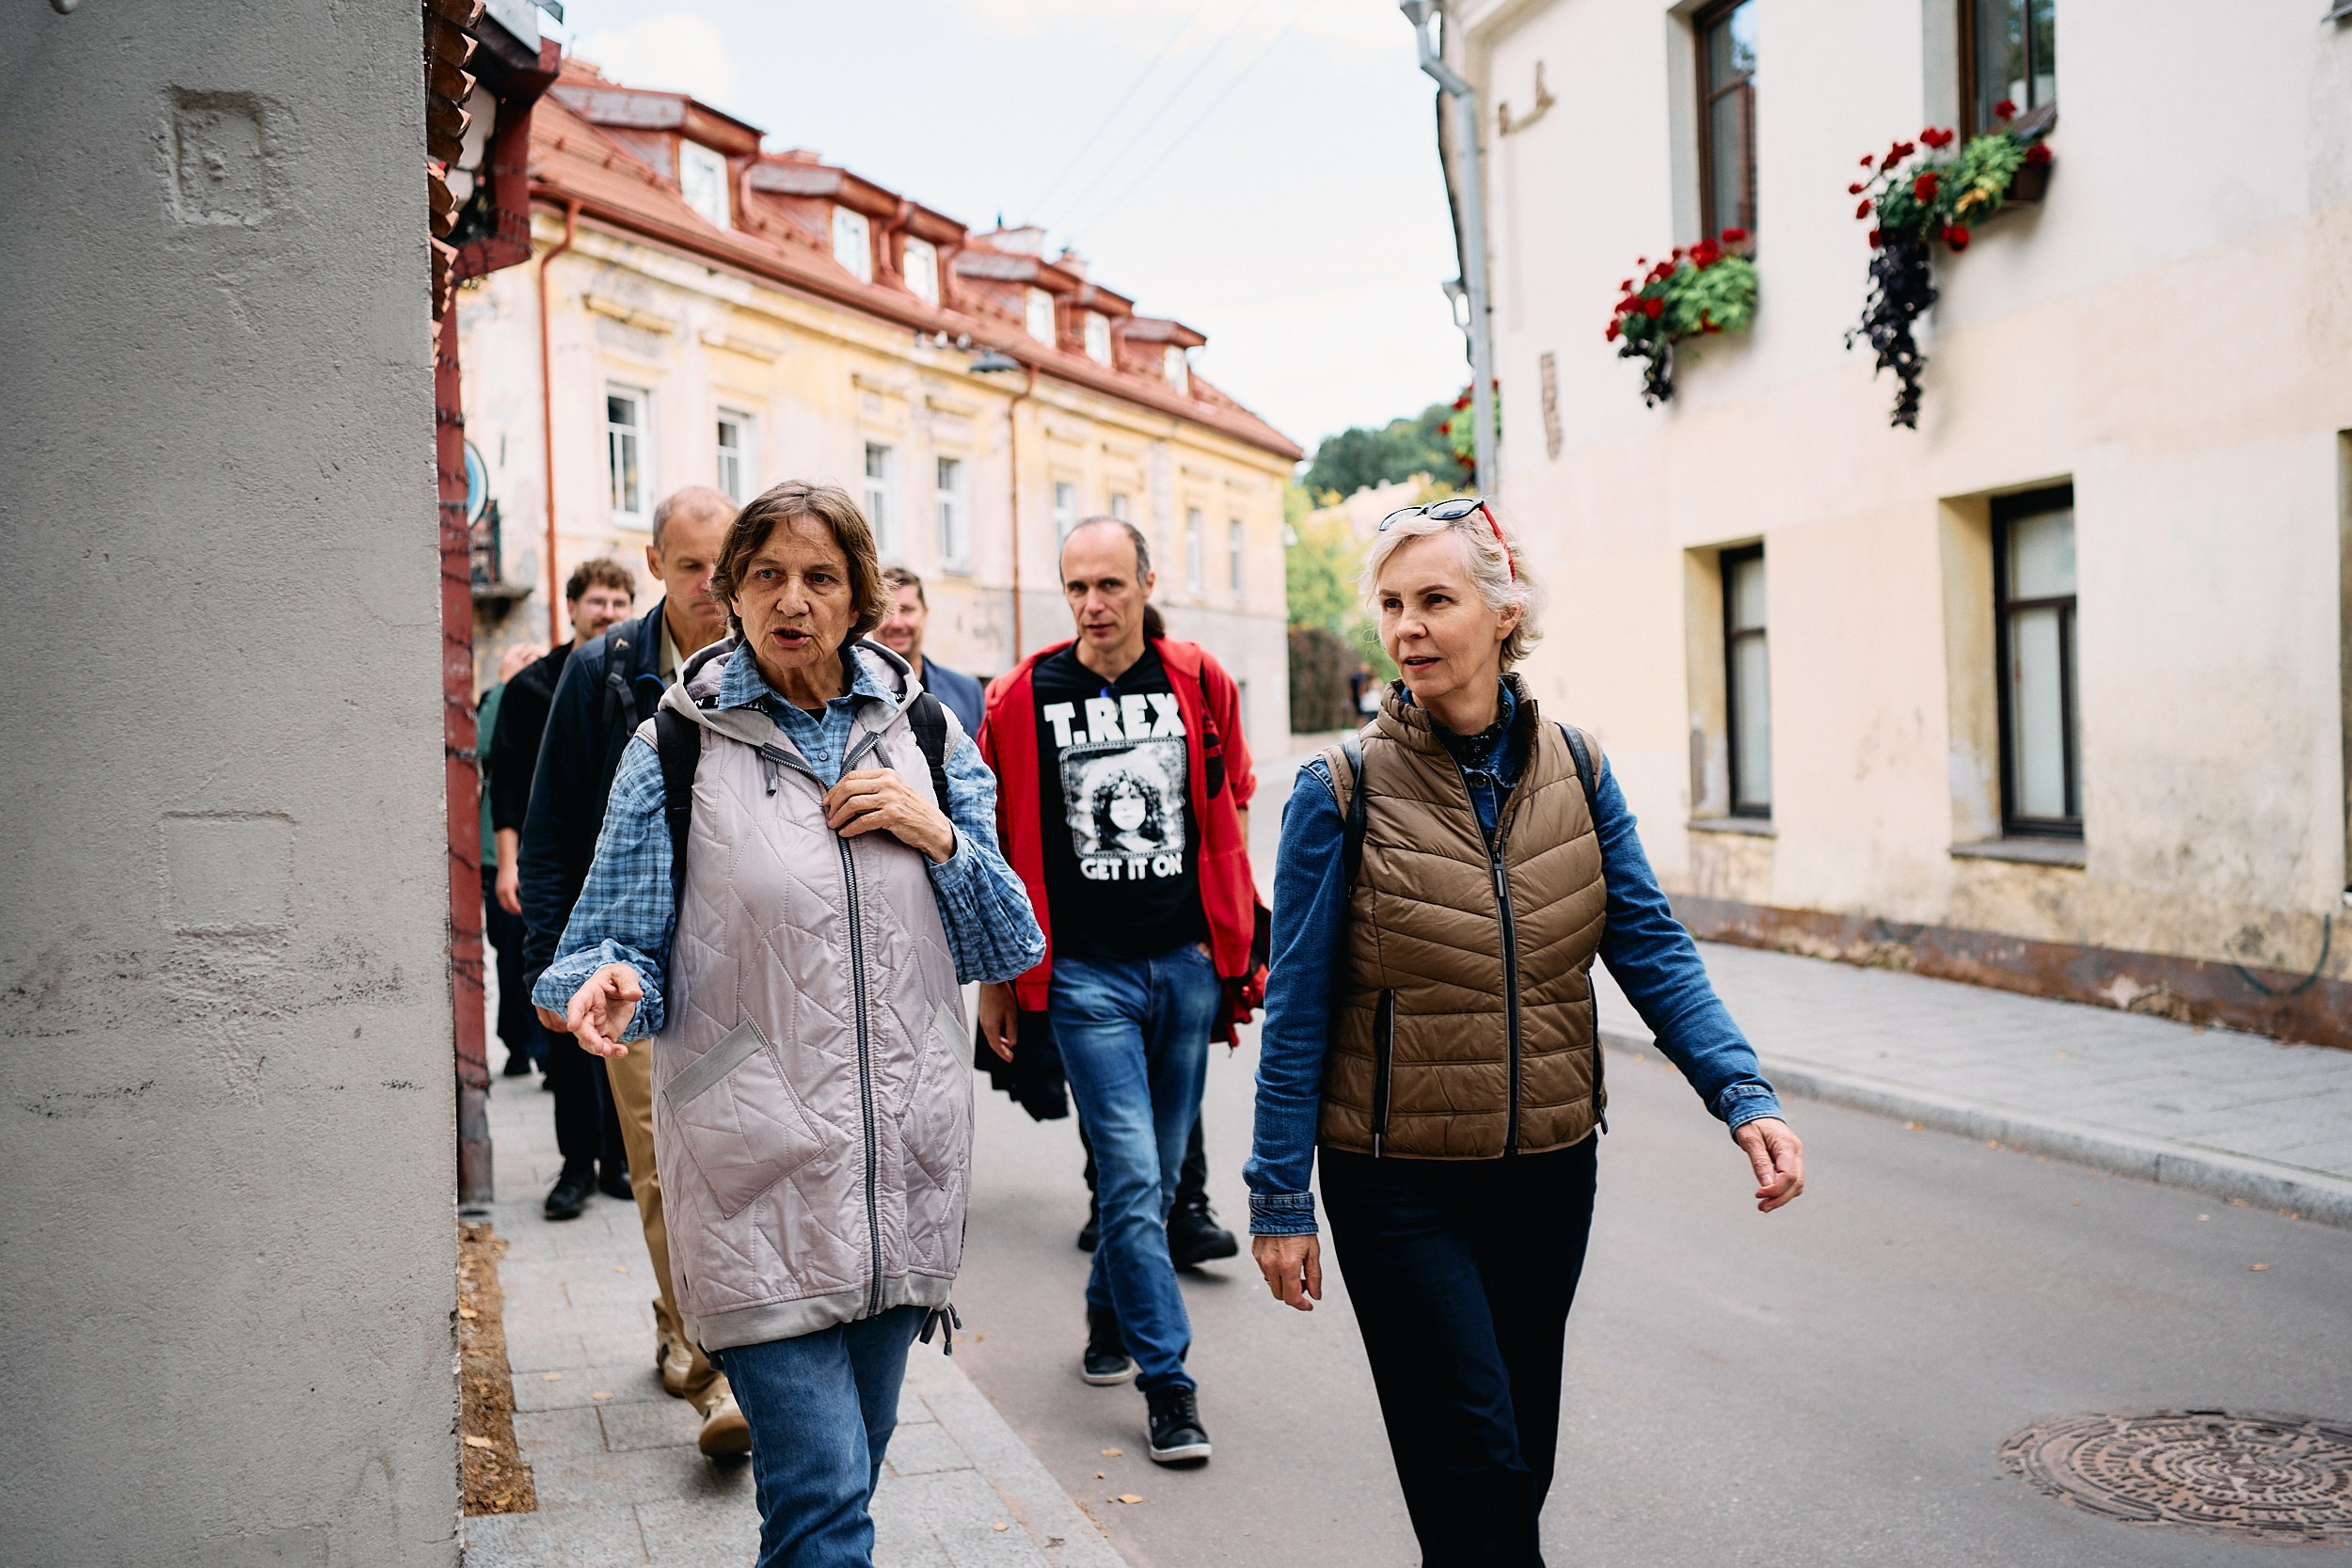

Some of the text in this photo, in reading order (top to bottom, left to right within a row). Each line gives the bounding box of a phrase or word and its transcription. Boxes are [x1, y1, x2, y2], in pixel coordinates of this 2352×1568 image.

[1043, 693, 1186, 748] T.REX
[1080, 853, 1183, 880] GET IT ON
